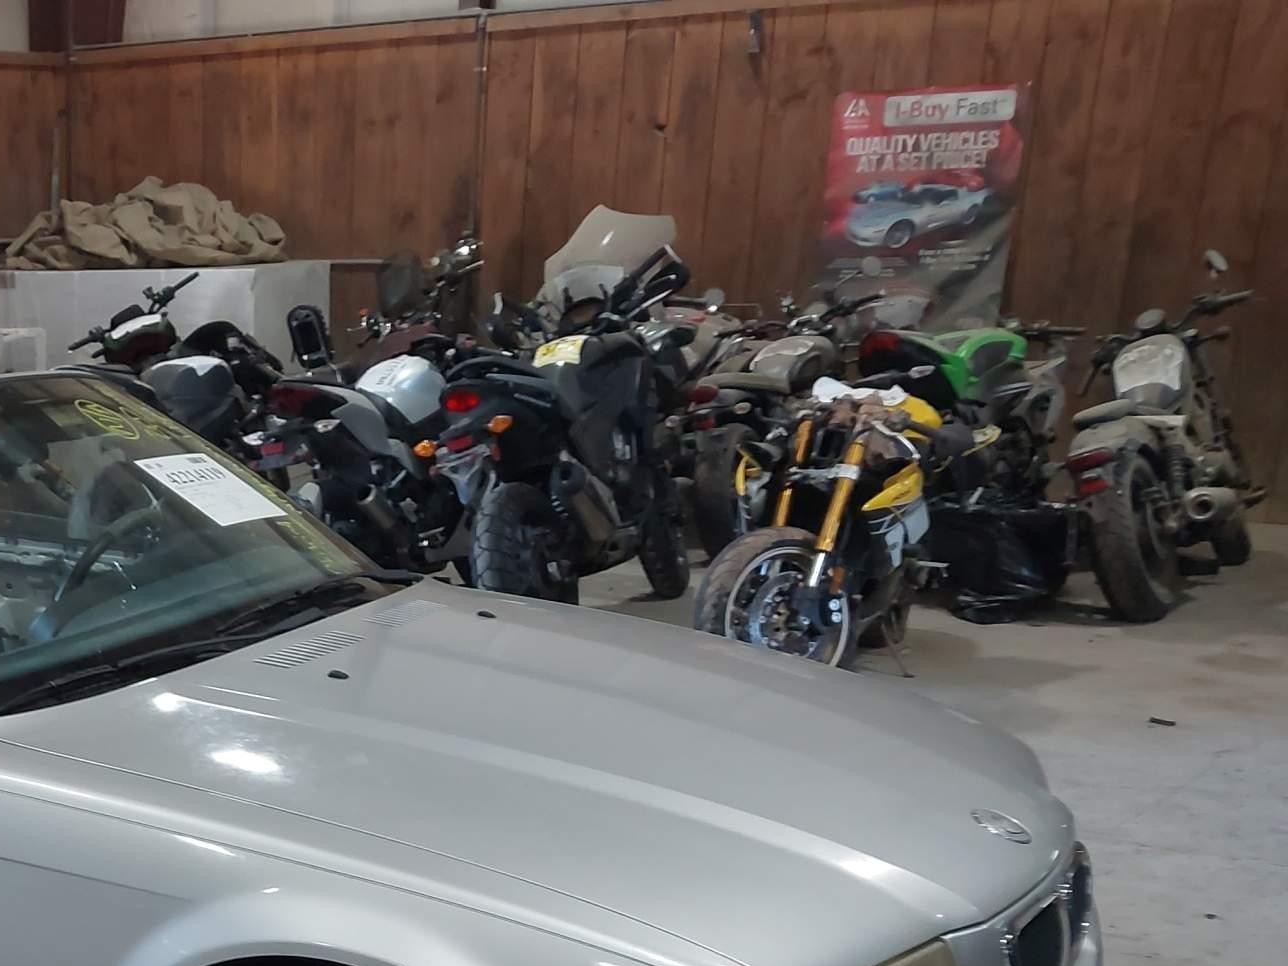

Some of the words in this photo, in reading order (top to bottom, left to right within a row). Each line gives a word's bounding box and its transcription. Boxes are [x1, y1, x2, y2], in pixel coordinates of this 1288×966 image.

[895, 100, 949, 121] I-Buy
[956, 98, 999, 116] Fast
[846, 133, 918, 155] QUALITY
[919, 129, 1000, 152] VEHICLES
[856, 153, 881, 173] AT
[880, 153, 895, 172] A
[898, 150, 932, 171] SET
[932, 148, 987, 169] PRICE!
[166, 467, 226, 485] 42214119
